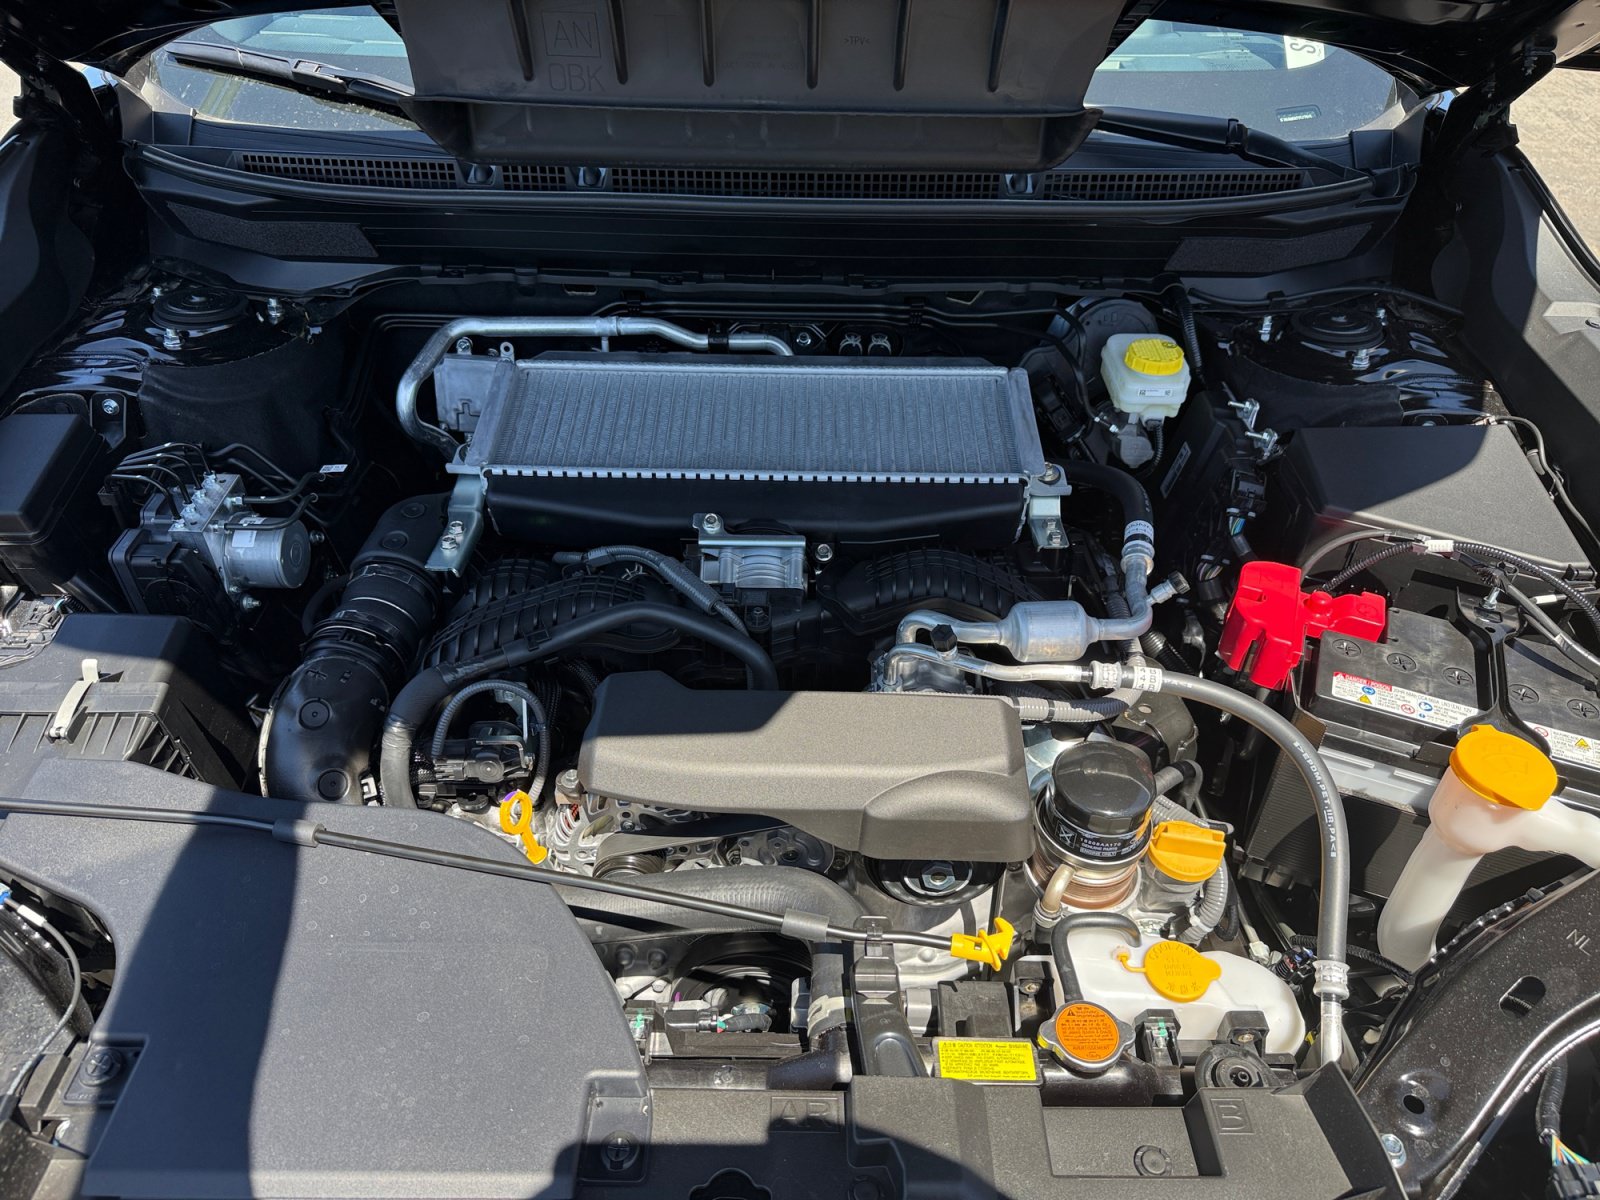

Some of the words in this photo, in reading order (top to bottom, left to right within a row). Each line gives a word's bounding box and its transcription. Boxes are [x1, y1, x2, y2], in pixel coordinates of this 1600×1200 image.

[553, 20, 593, 49] AN
[548, 62, 606, 92] OBK
[1345, 674, 1368, 685] DANGER
[1565, 928, 1593, 957] NL
[1217, 1103, 1247, 1131] B
